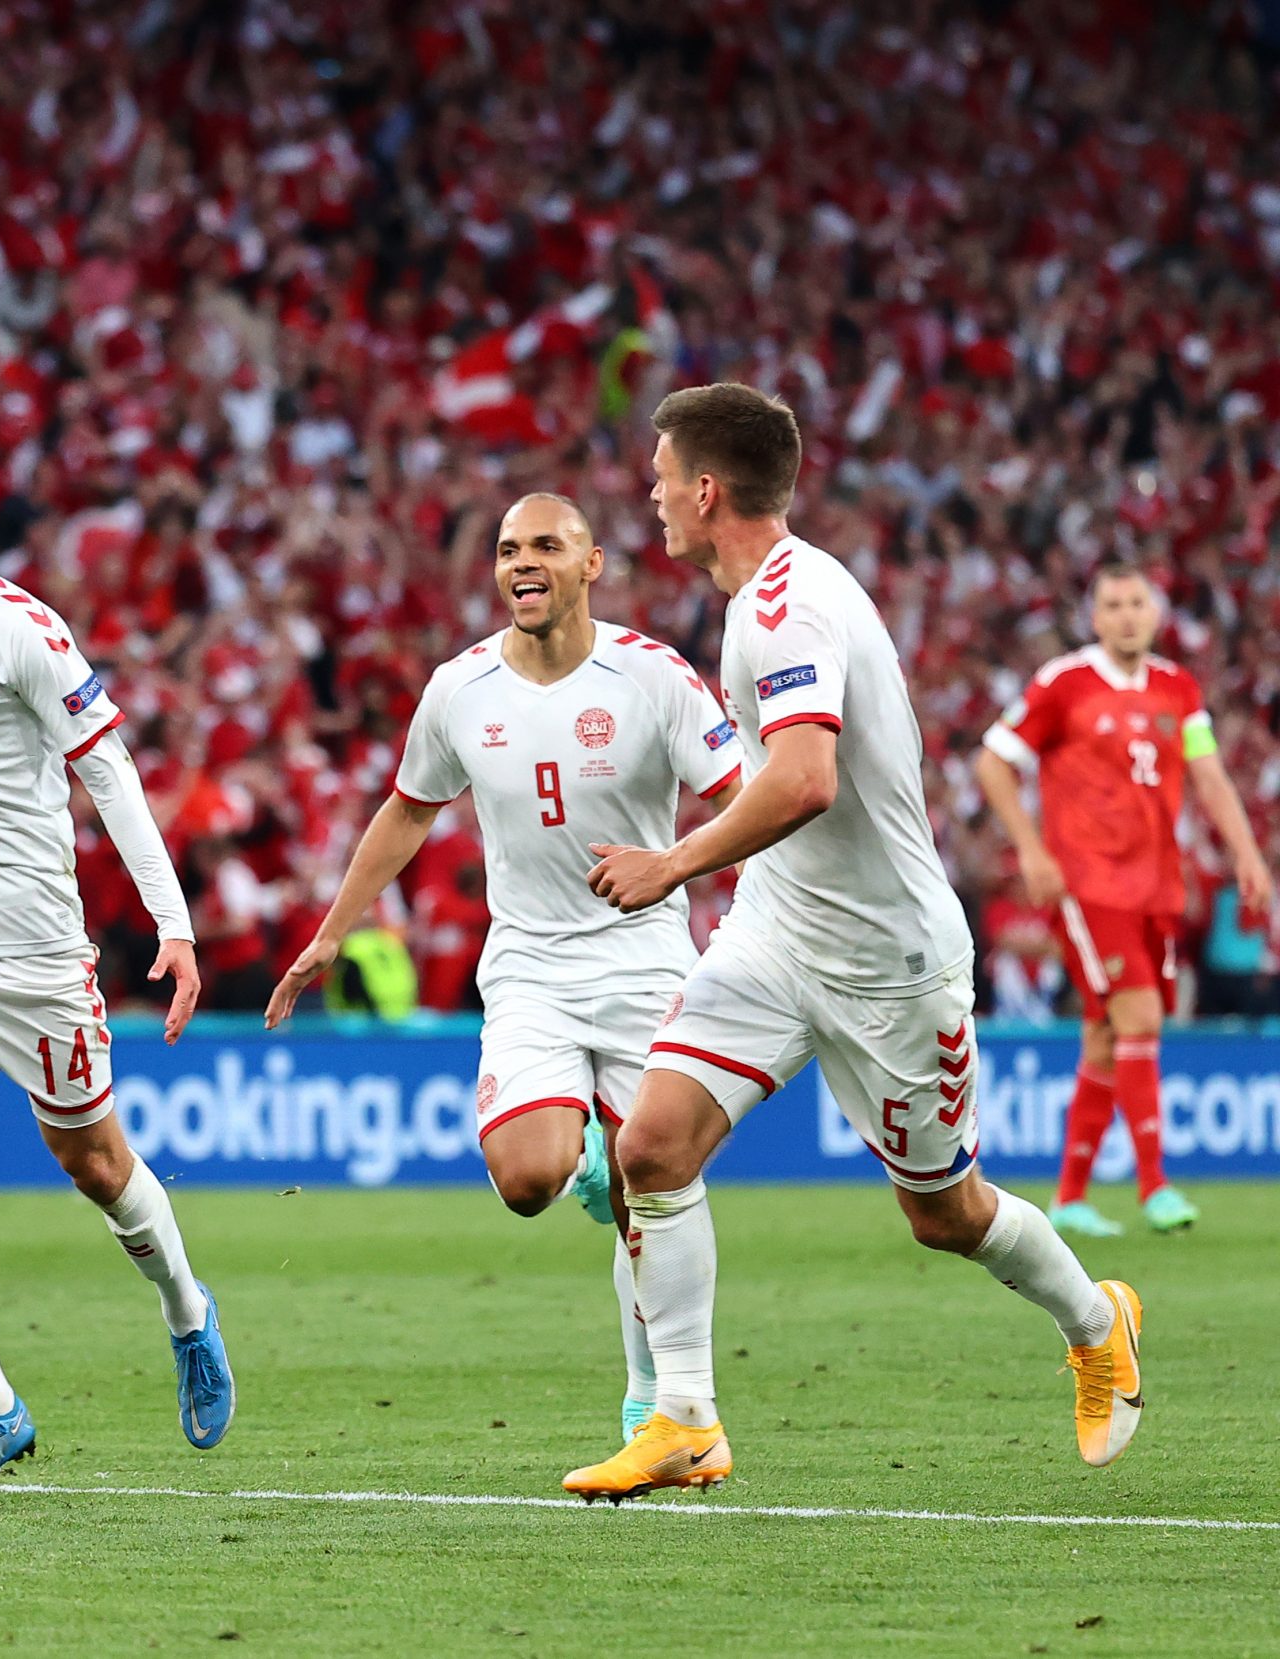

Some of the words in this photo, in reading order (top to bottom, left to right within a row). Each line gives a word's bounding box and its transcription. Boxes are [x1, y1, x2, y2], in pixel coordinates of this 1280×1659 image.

[771, 669, 815, 688] RESPECT
[583, 721, 608, 735] DBU
[535, 762, 565, 827] 9
[37, 1027, 92, 1096] 14
[883, 1098, 910, 1158] 5
